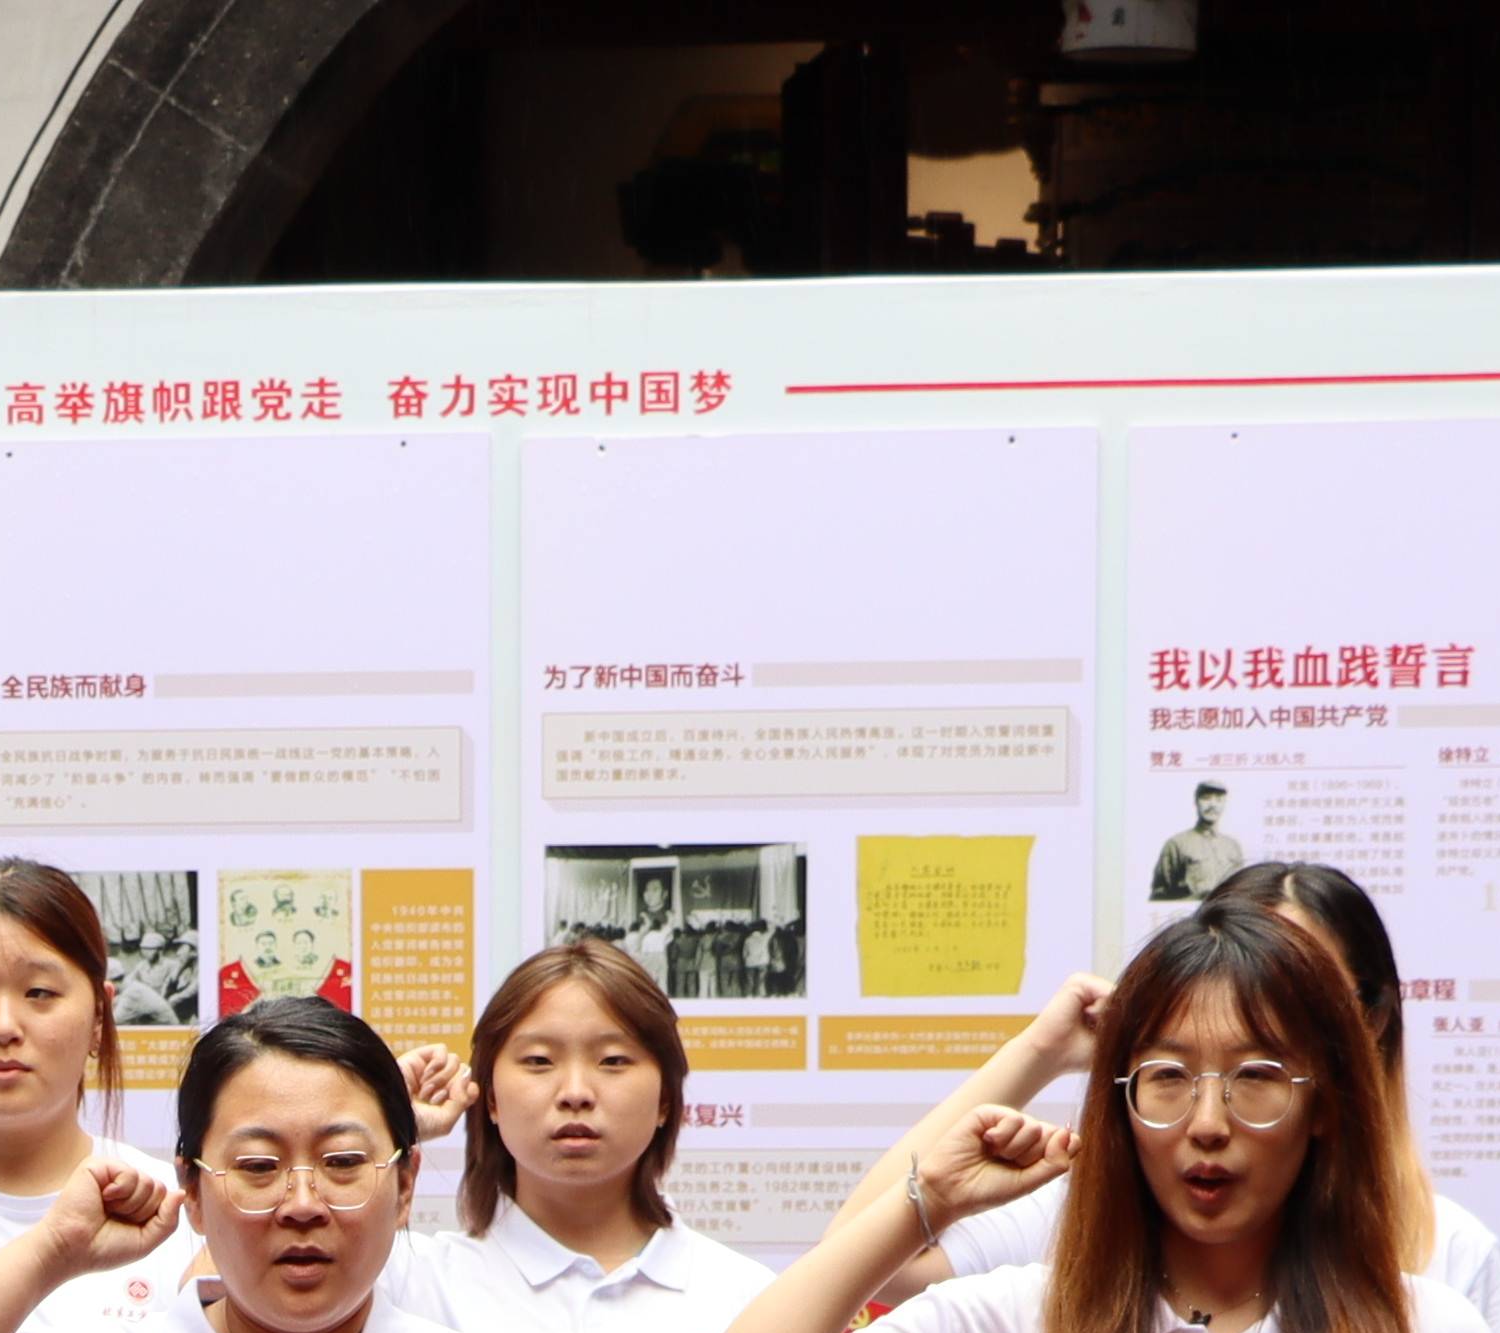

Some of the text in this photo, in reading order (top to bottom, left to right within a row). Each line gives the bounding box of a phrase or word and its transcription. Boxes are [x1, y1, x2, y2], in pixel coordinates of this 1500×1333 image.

[4, 369, 734, 427] 高举旗帜跟党走 奋力实现中国梦
[541, 661, 746, 691] 为了新中国而奋斗
[1148, 642, 1476, 692] 我以我血践誓言
[1148, 704, 1390, 731] 我志愿加入中国共产党
